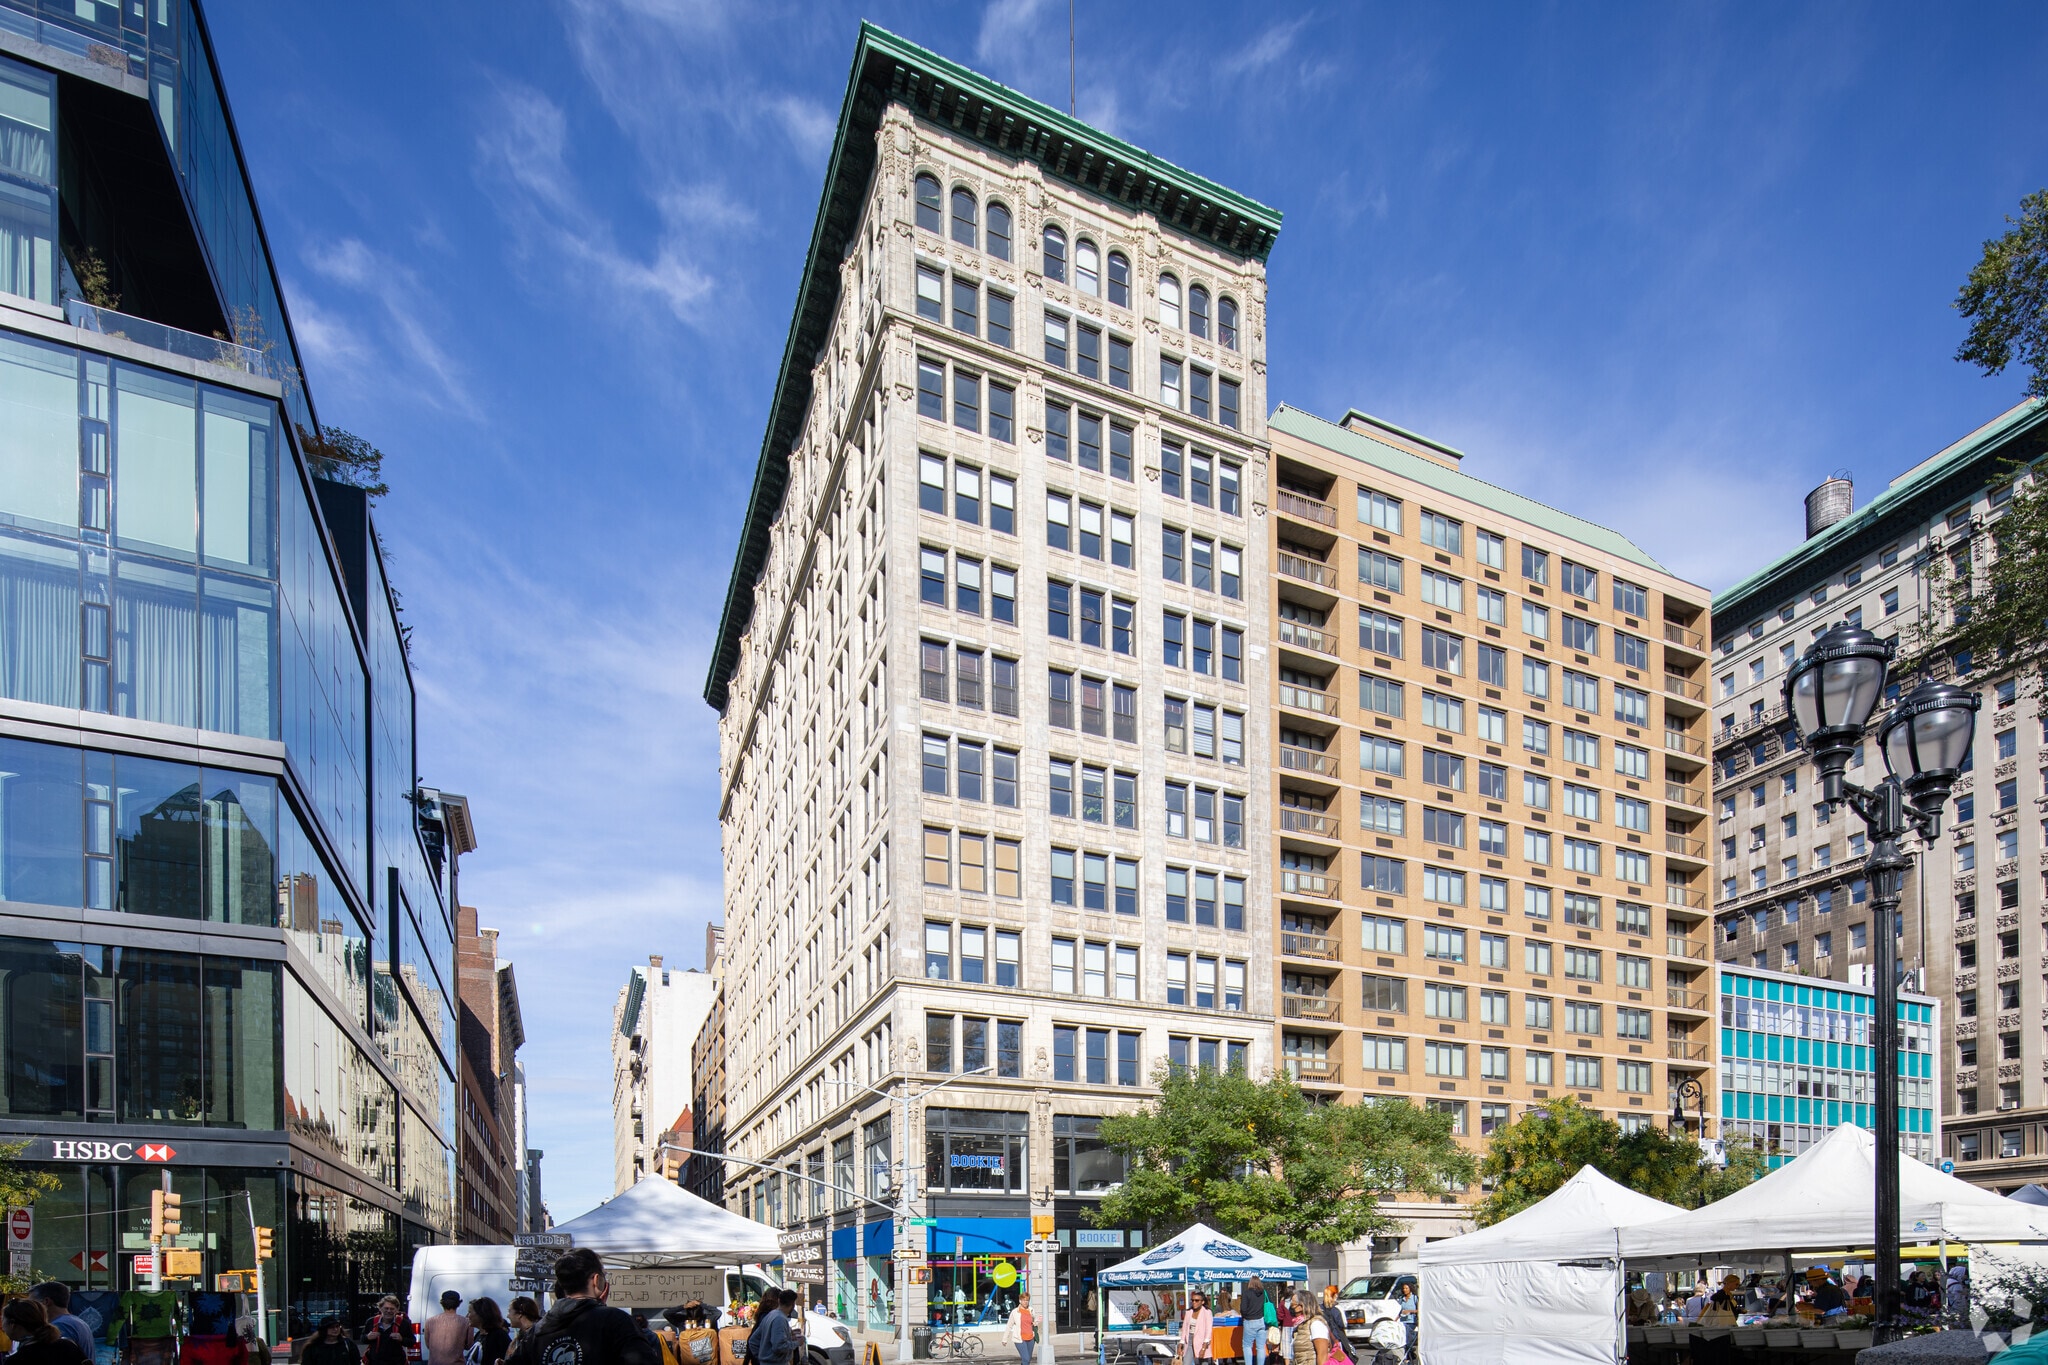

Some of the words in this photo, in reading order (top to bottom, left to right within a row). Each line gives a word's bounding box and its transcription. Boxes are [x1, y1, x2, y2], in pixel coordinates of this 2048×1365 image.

[53, 1140, 132, 1160] HSBC
[951, 1154, 1000, 1168] ROOKIE
[991, 1168, 1005, 1176] KIDS
[537, 1234, 553, 1244] ICED
[552, 1234, 564, 1245] TEA
[779, 1229, 824, 1244] APOTHECARY
[1080, 1233, 1117, 1243] ROOKIE
[783, 1247, 820, 1264] HERBS
[1129, 1271, 1147, 1281] Valley
[1146, 1270, 1173, 1281] Fisheries
[1203, 1270, 1234, 1281] Hudson
[1235, 1269, 1259, 1280] Valley
[1259, 1269, 1292, 1280] Fisheries
[509, 1281, 526, 1290] NEW
[659, 1290, 705, 1301] FARM
